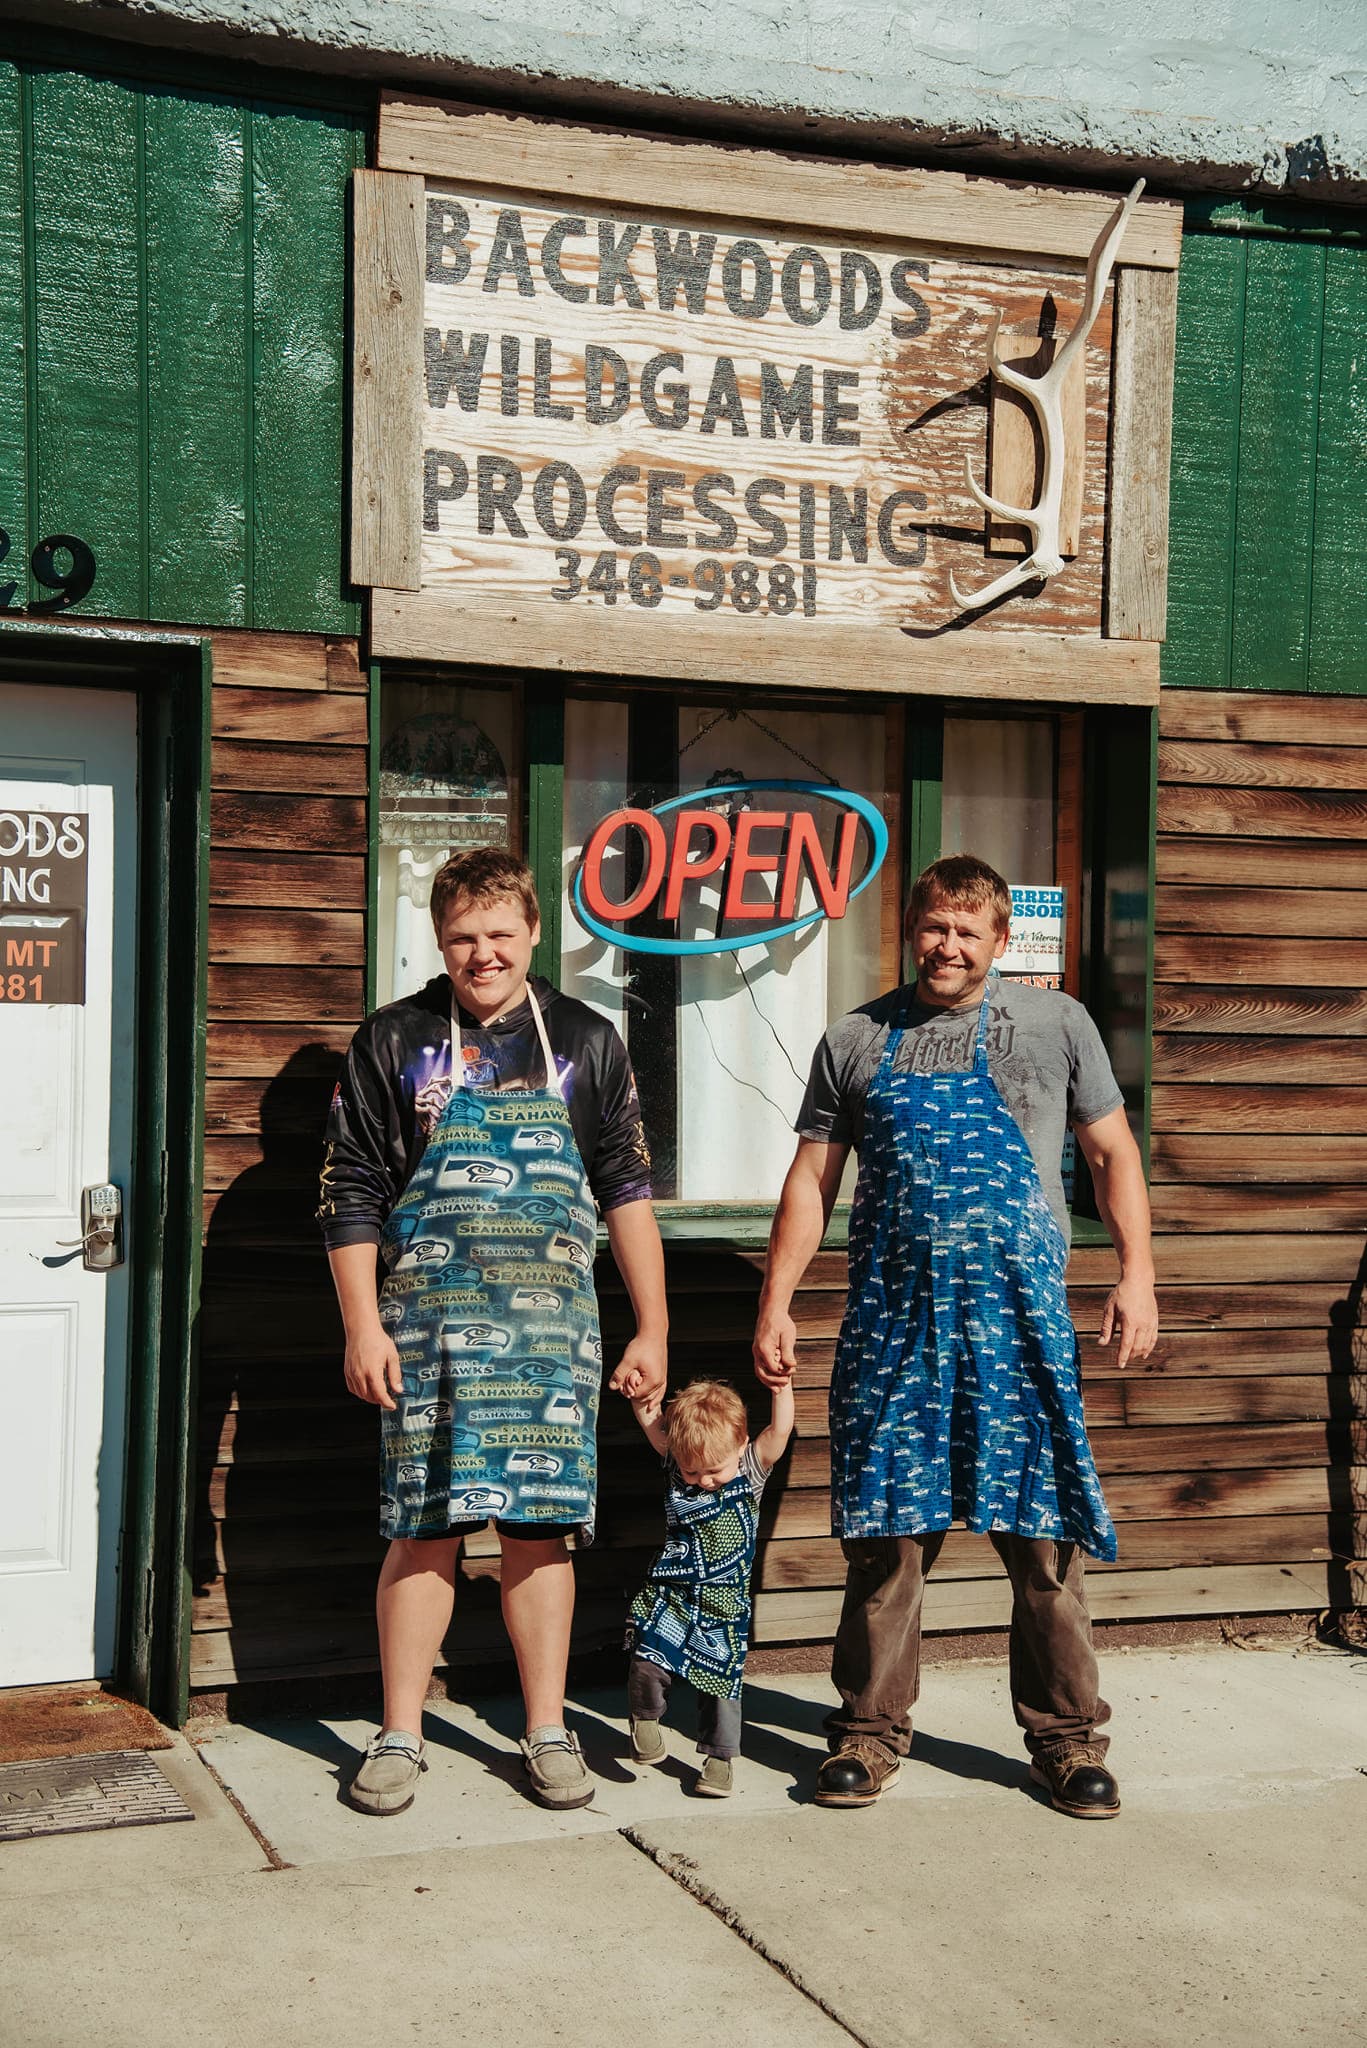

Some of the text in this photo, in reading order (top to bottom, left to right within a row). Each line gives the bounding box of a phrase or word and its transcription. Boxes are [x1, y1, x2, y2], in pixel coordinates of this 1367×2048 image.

[425, 198, 932, 340] BACKWOODS
[424, 328, 862, 447] WILDGAME
[423, 447, 928, 568] PROCESSING
[0, 812, 86, 859] ODS
[391, 822, 499, 840] WELCOME
[583, 807, 858, 921] OPEN
[1011, 889, 1064, 904] RRED
[1013, 904, 1064, 918] SSOR
[6, 939, 58, 968] MT
[0, 973, 44, 1001] 81
[489, 1109, 569, 1122] SEAHAW
[458, 1224, 544, 1235] SEAHAWKS
[485, 1269, 578, 1287] SEAHAWKS
[457, 1386, 541, 1399] SEAHAWKS
[469, 1409, 531, 1421] SEAHAWKS
[502, 1426, 571, 1434] SEATTLE
